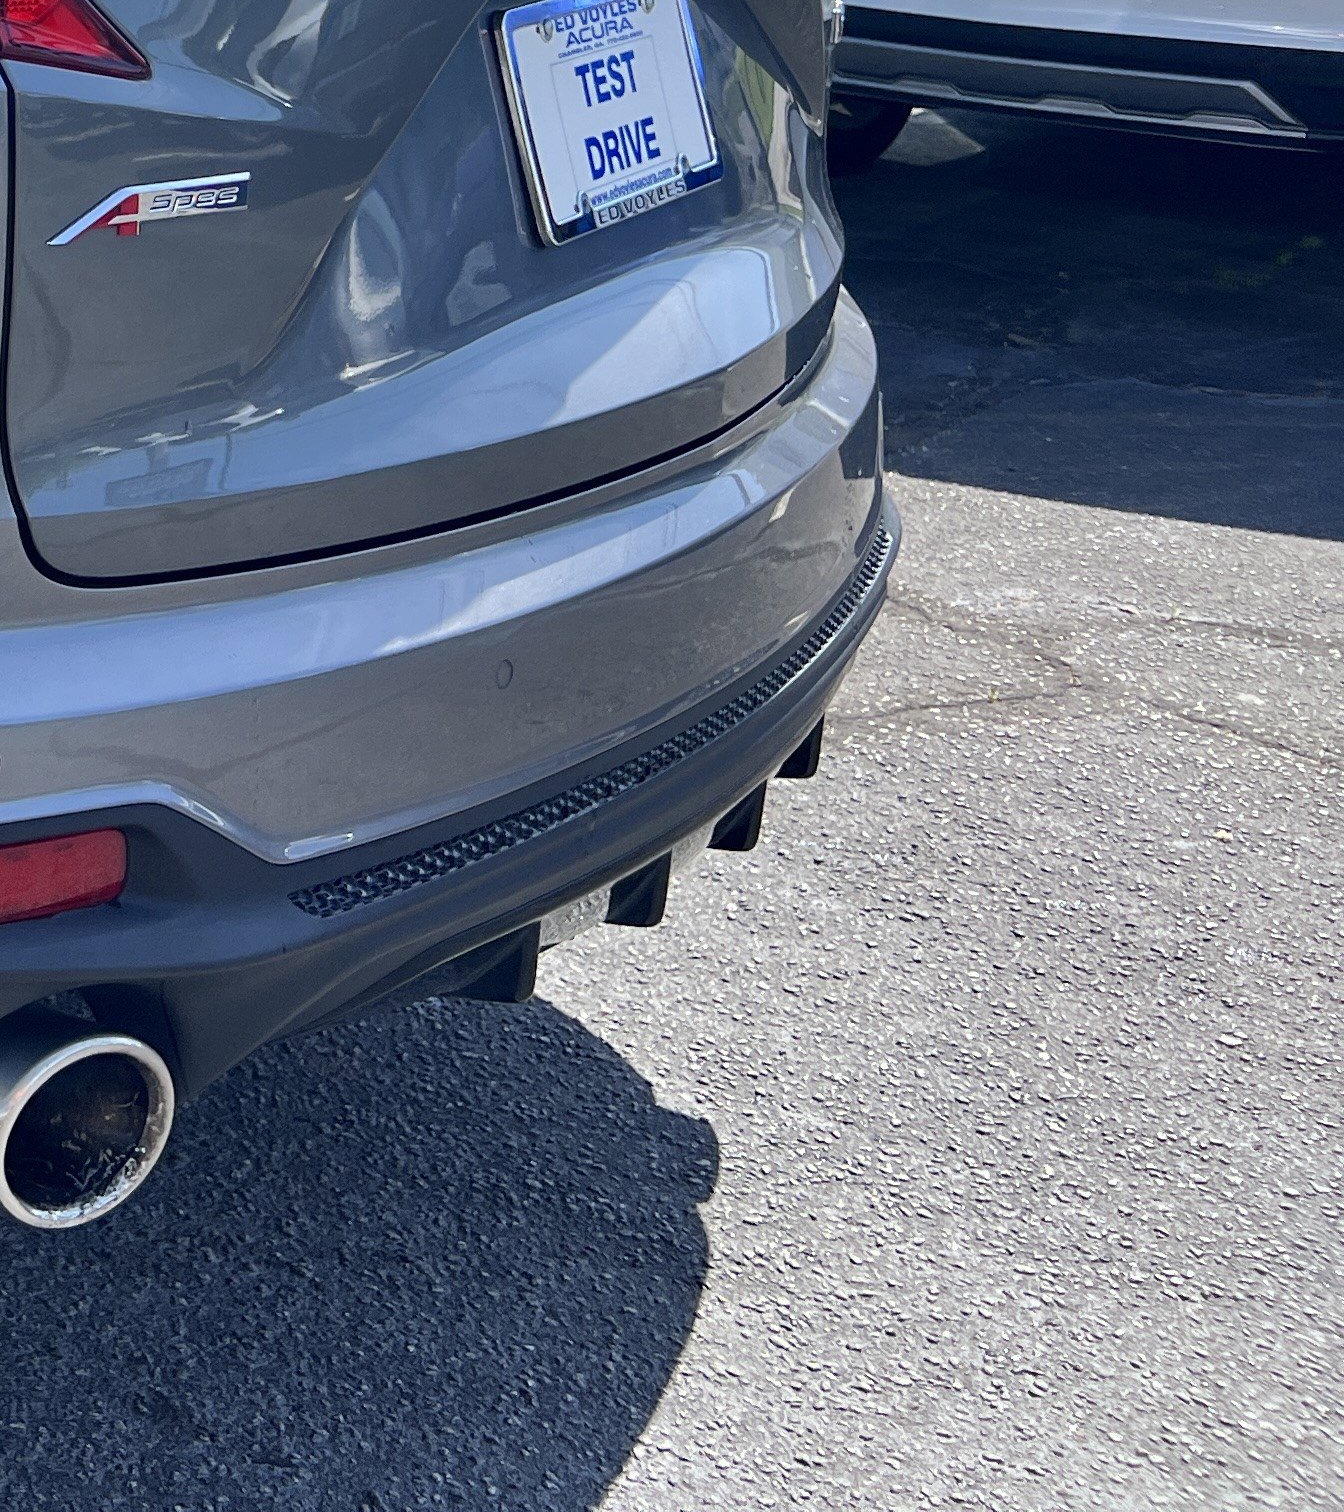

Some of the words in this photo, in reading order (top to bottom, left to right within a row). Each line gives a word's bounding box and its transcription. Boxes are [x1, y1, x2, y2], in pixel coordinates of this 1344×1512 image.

[554, 13, 576, 33] ED
[566, 16, 634, 49] ACURA
[574, 50, 637, 107] TEST
[584, 116, 661, 181] DRIVE
[597, 205, 621, 225] ED
[623, 178, 687, 215] VOYLES
